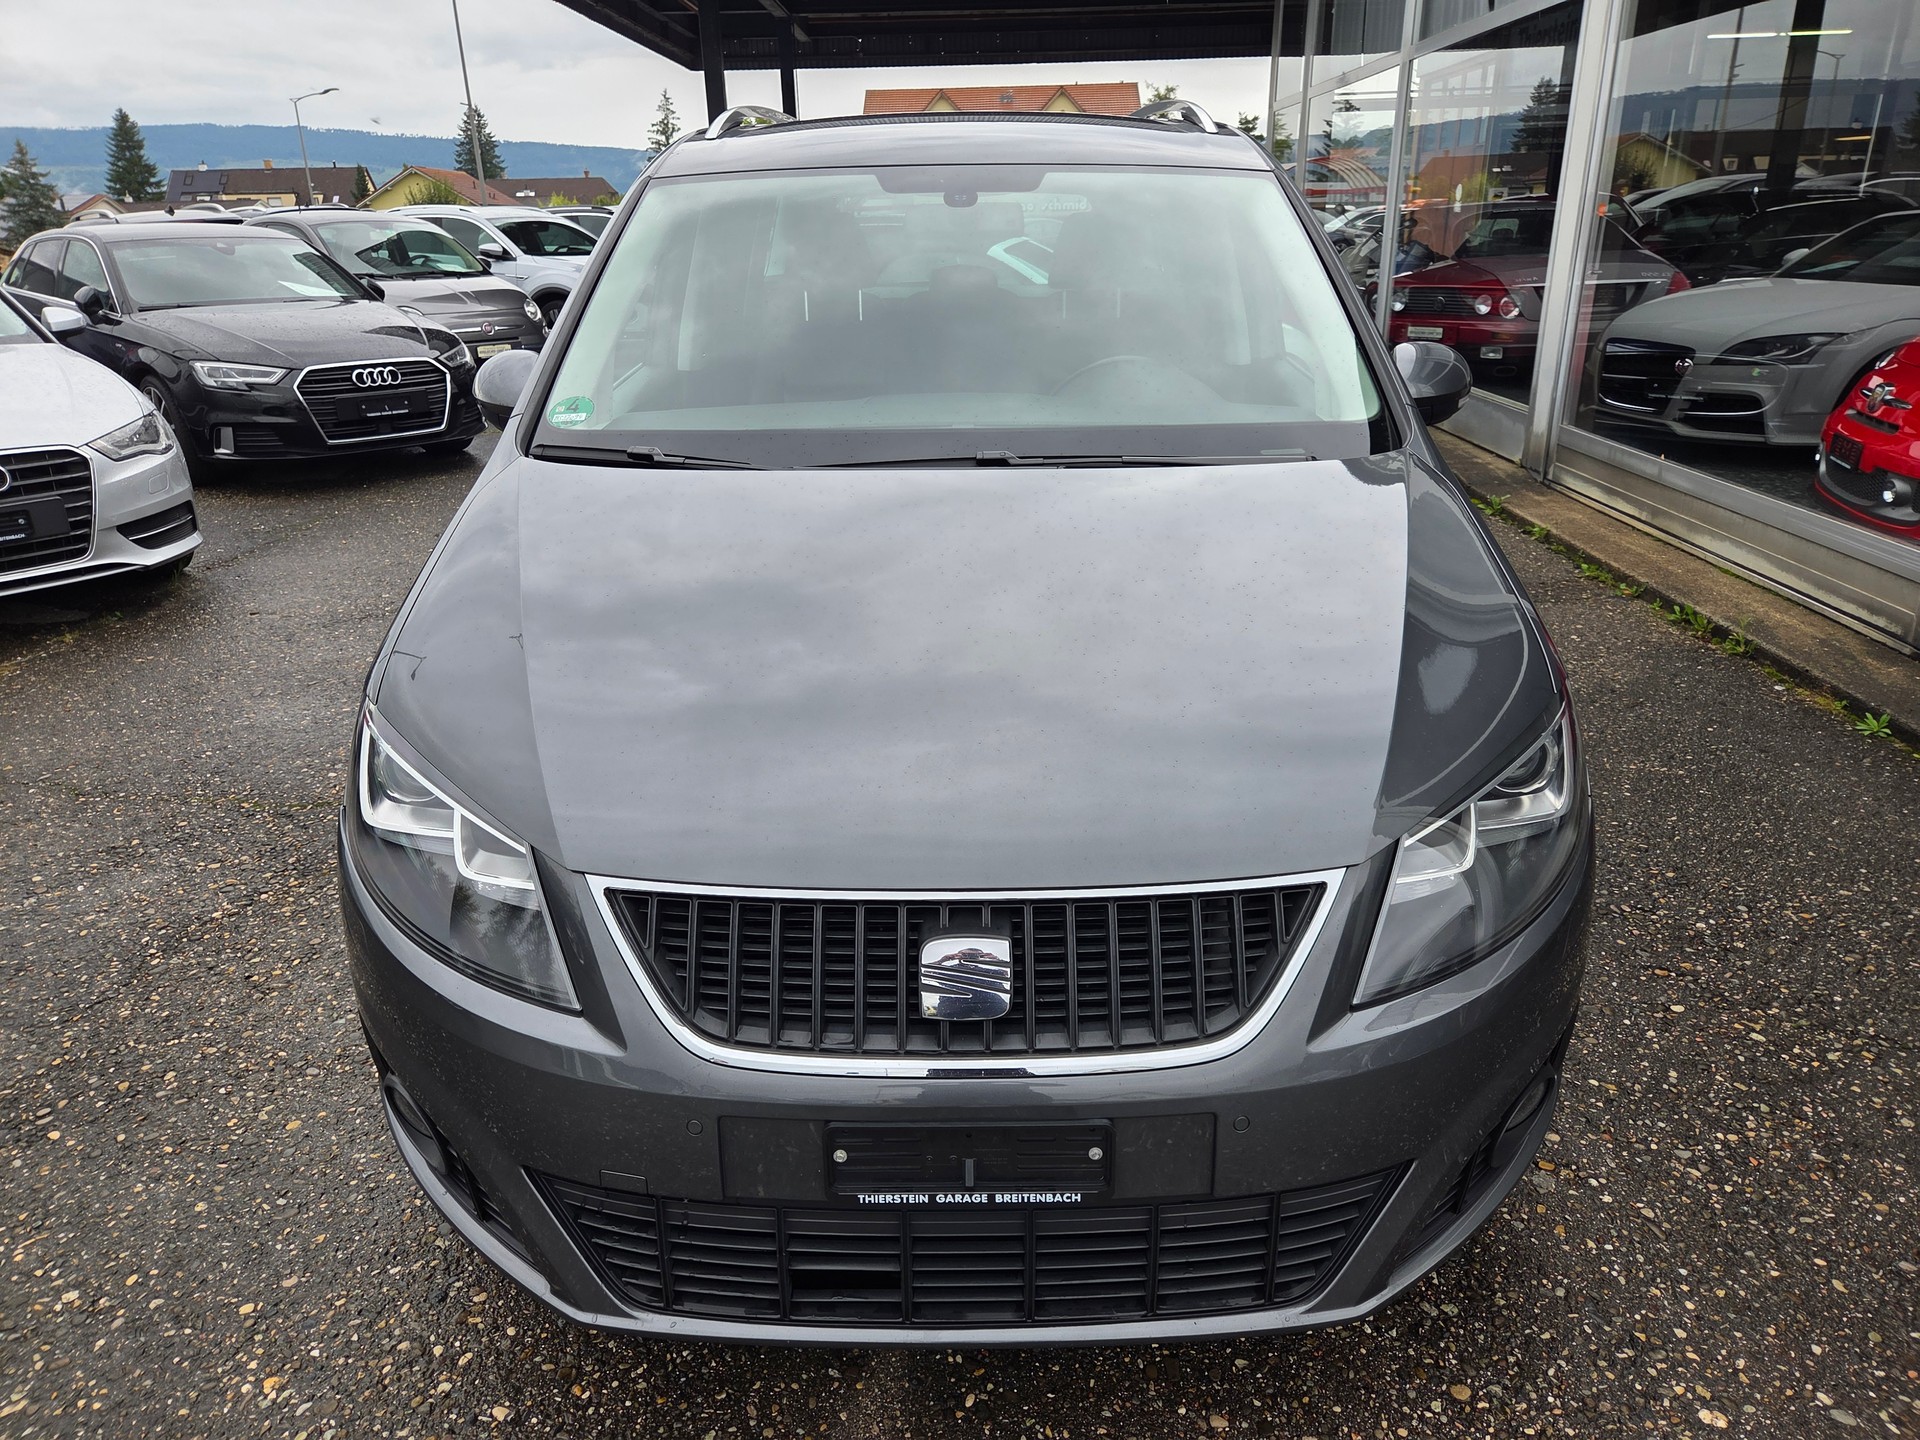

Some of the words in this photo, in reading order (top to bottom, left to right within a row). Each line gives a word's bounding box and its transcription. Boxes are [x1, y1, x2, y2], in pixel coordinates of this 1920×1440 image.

[566, 398, 580, 413] 4
[857, 1194, 929, 1204] THIERSTEIN
[935, 1194, 988, 1204] GARAGE
[995, 1193, 1081, 1203] BREITENBACH
